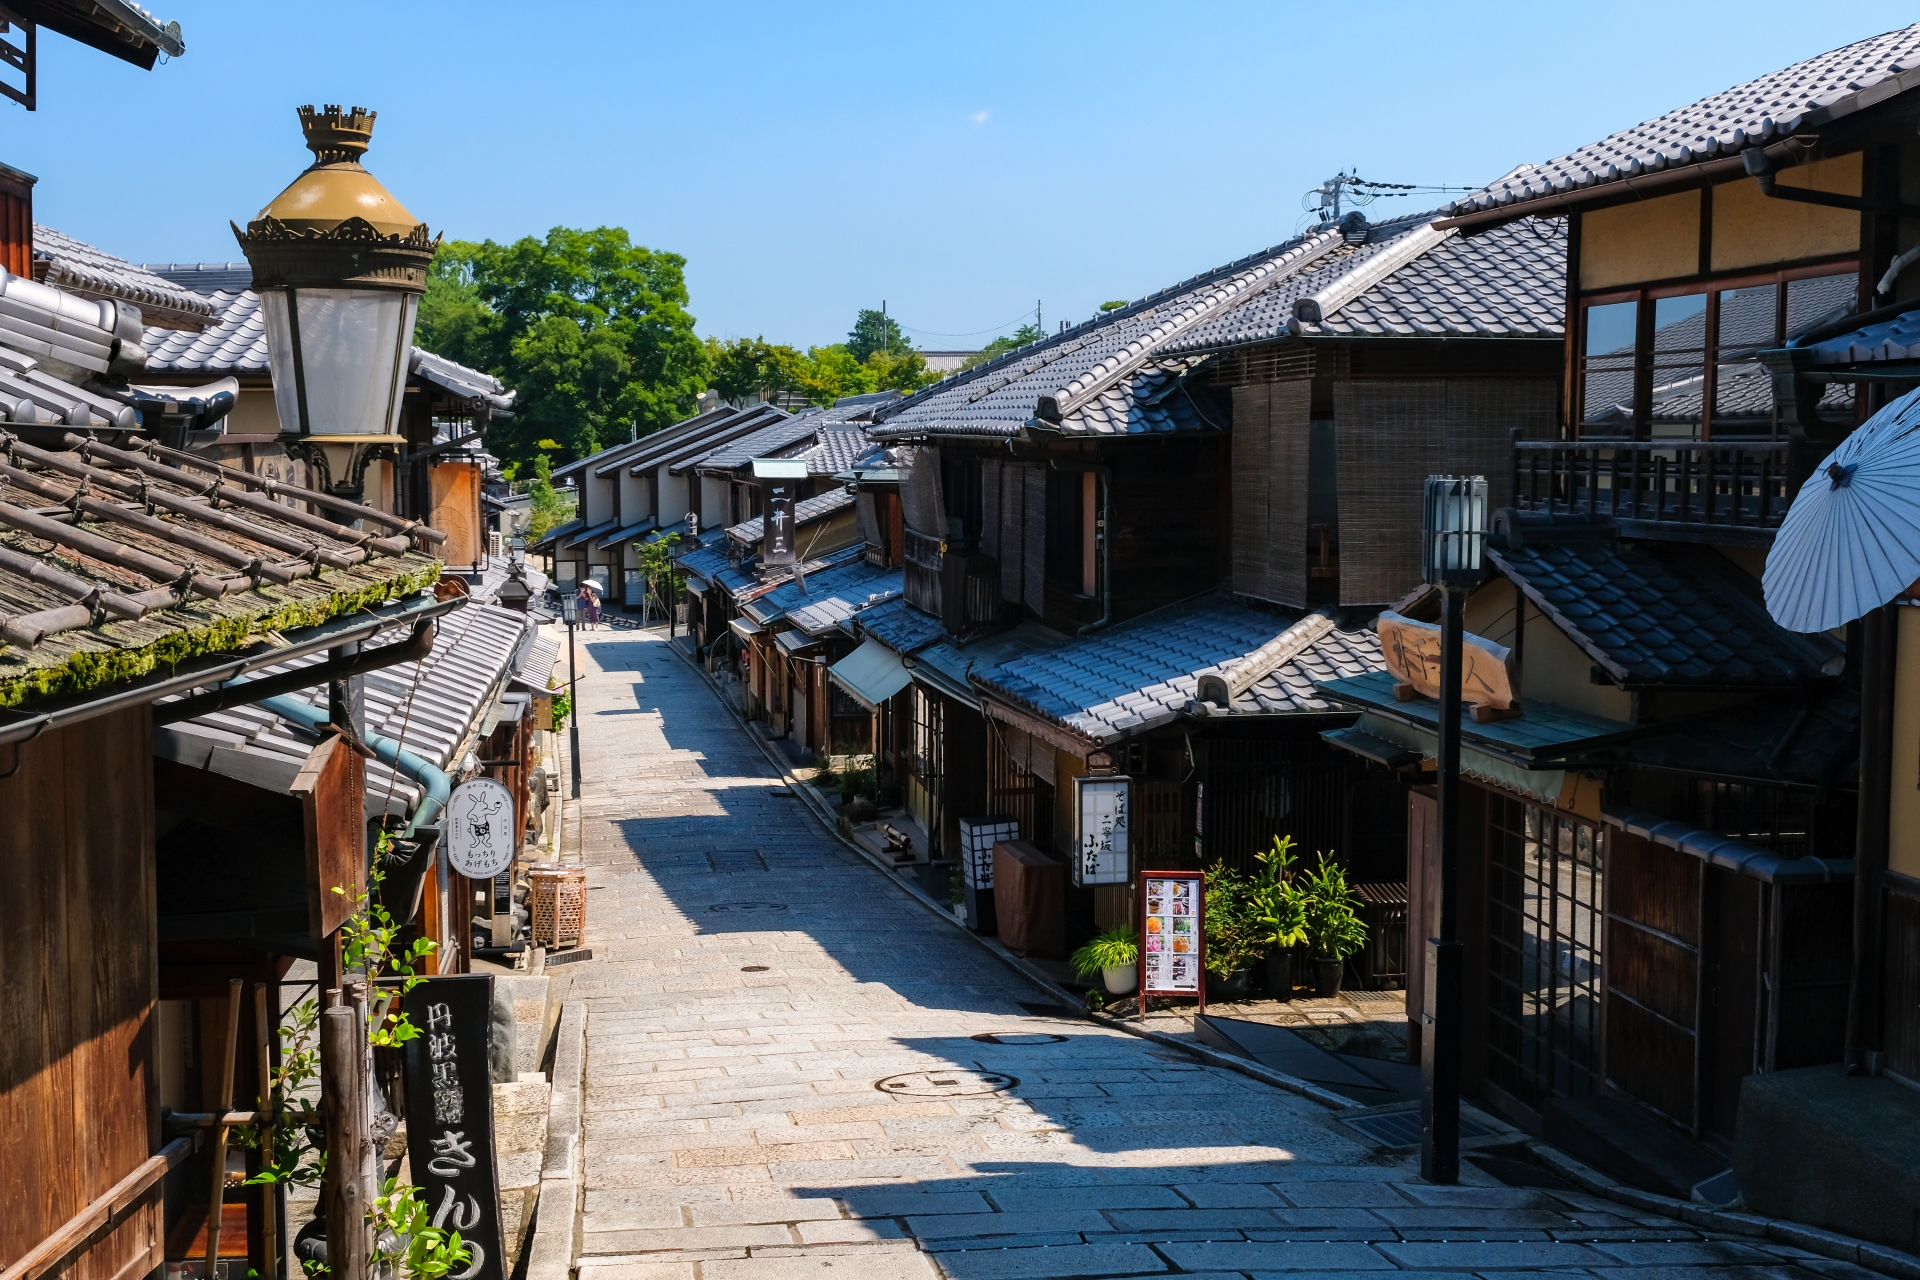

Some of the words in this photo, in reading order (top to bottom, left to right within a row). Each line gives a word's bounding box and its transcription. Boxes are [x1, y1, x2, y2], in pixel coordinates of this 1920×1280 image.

[1114, 790, 1126, 828] そば処
[464, 858, 498, 869] あげもち
[467, 850, 496, 859] もっちり
[1084, 834, 1100, 875] ふたば
